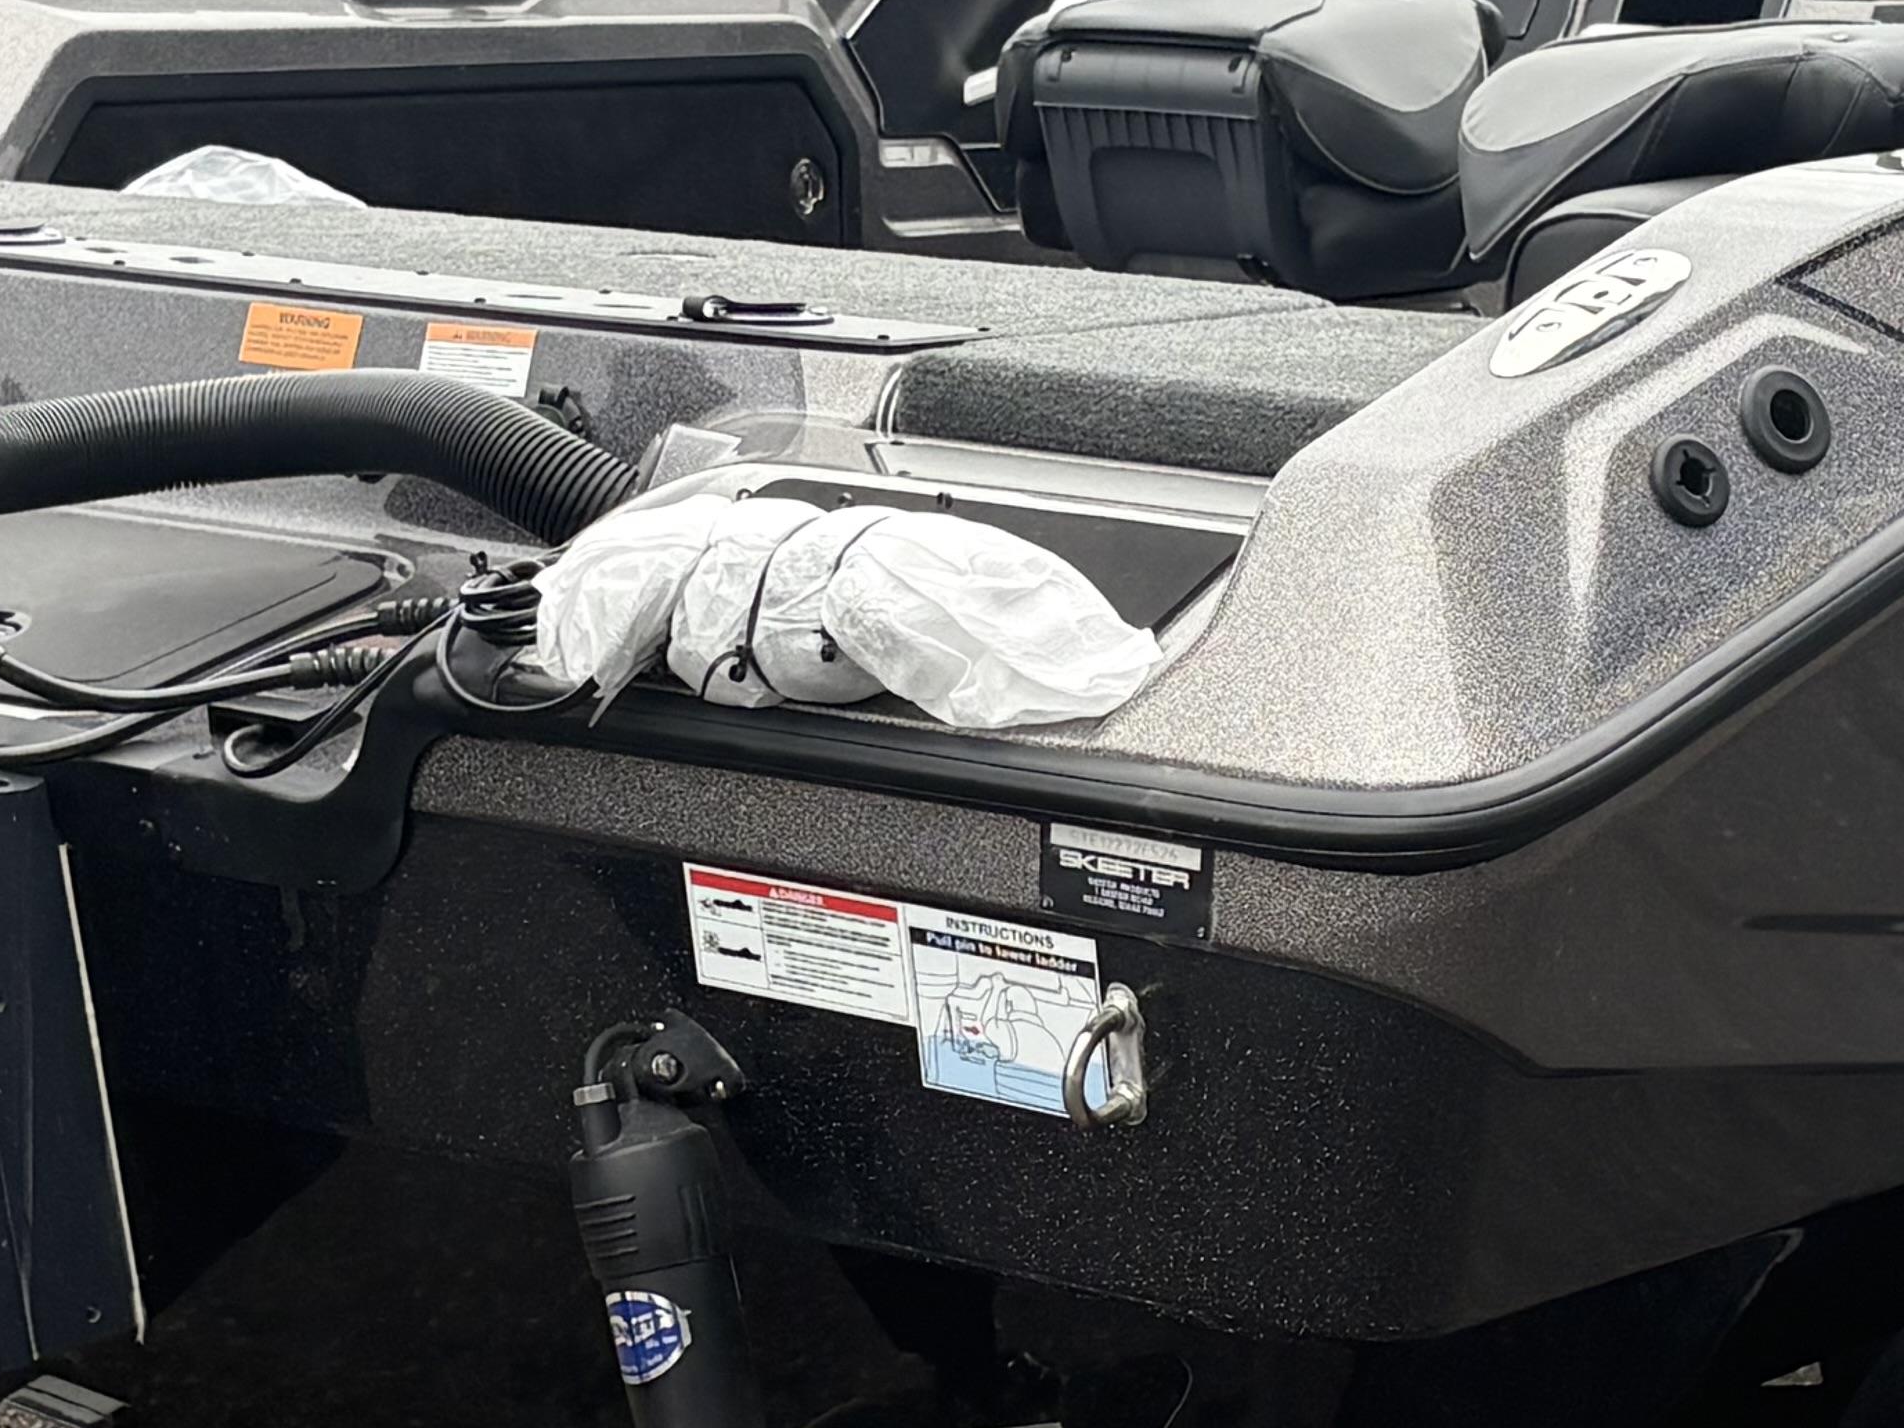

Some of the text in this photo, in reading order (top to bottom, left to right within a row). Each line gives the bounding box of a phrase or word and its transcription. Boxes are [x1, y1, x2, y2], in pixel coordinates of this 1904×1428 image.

[1059, 849, 1190, 890] SKEETER
[926, 931, 1078, 972] Pull pin to lower ladder
[946, 916, 1055, 949] INSTRUCTIONS
